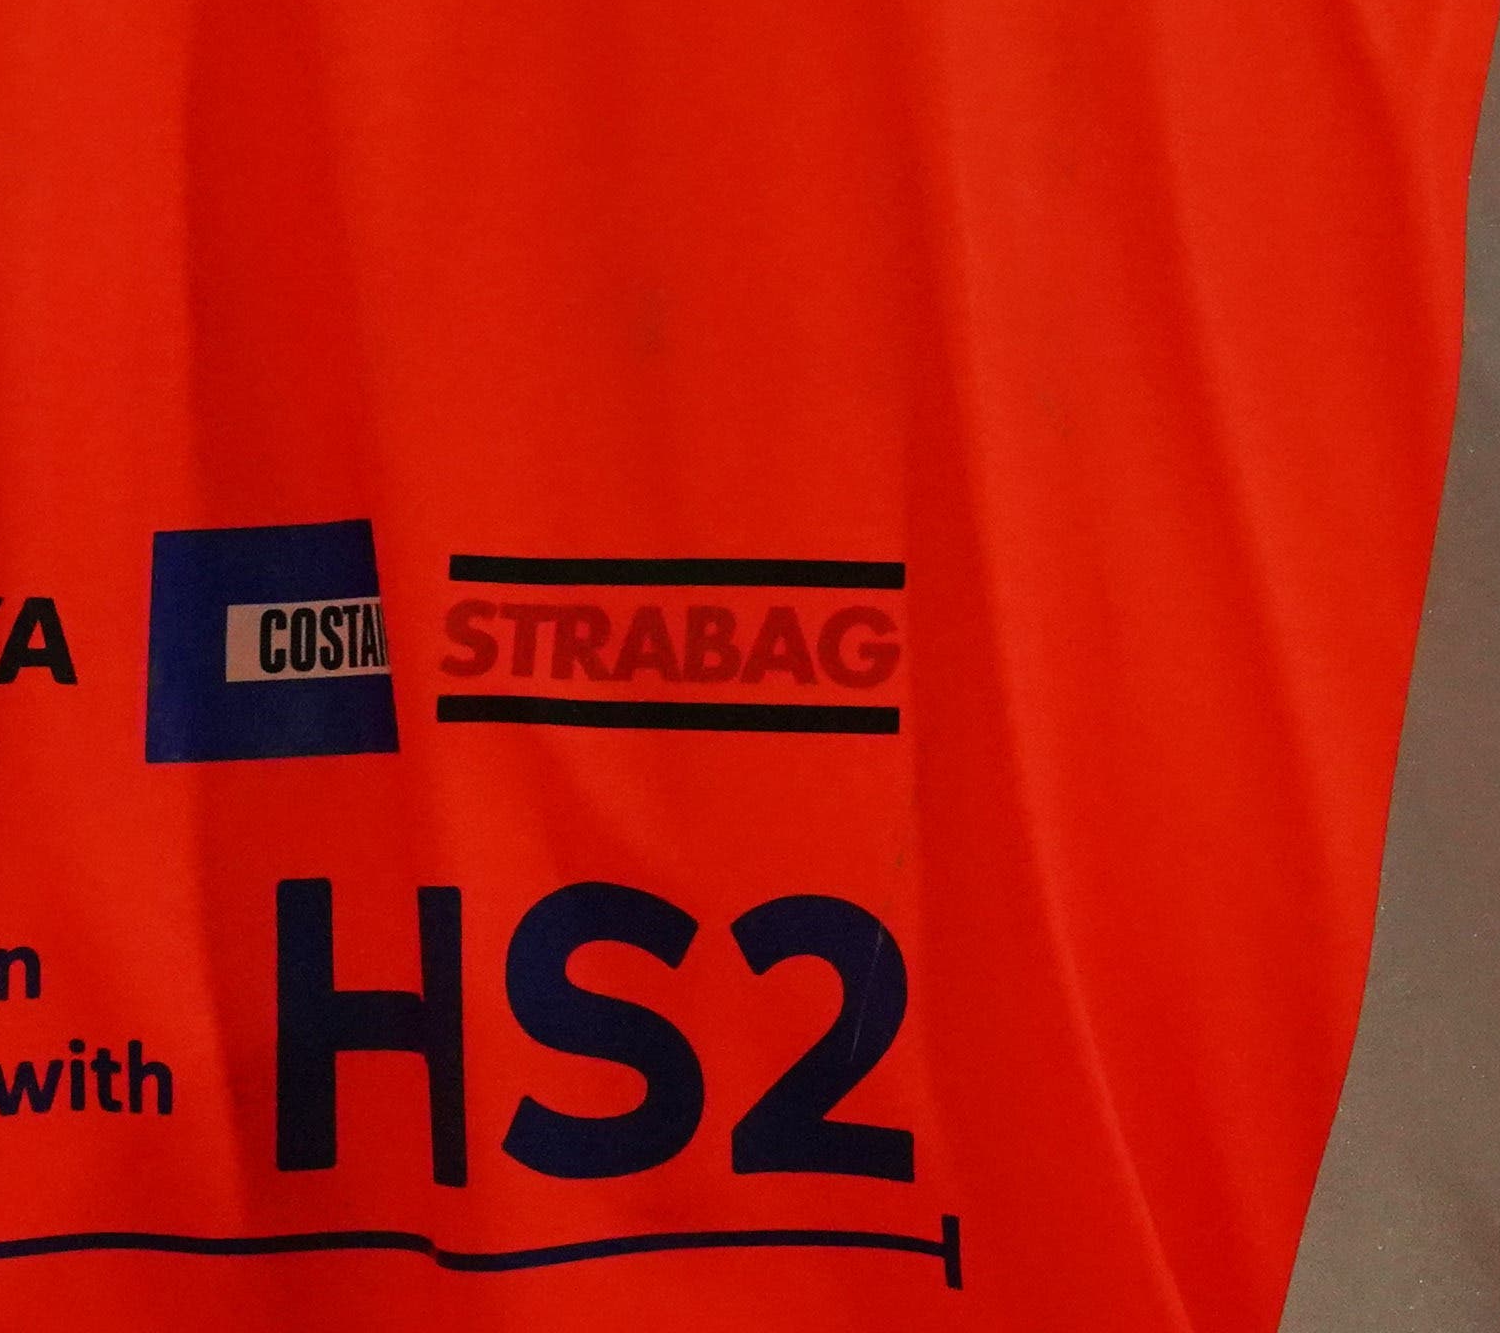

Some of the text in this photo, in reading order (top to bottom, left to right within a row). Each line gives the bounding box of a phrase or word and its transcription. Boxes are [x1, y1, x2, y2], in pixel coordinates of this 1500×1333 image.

[259, 603, 390, 674] COSTAI
[439, 599, 901, 689] STRABAG
[275, 876, 916, 1189] HS2
